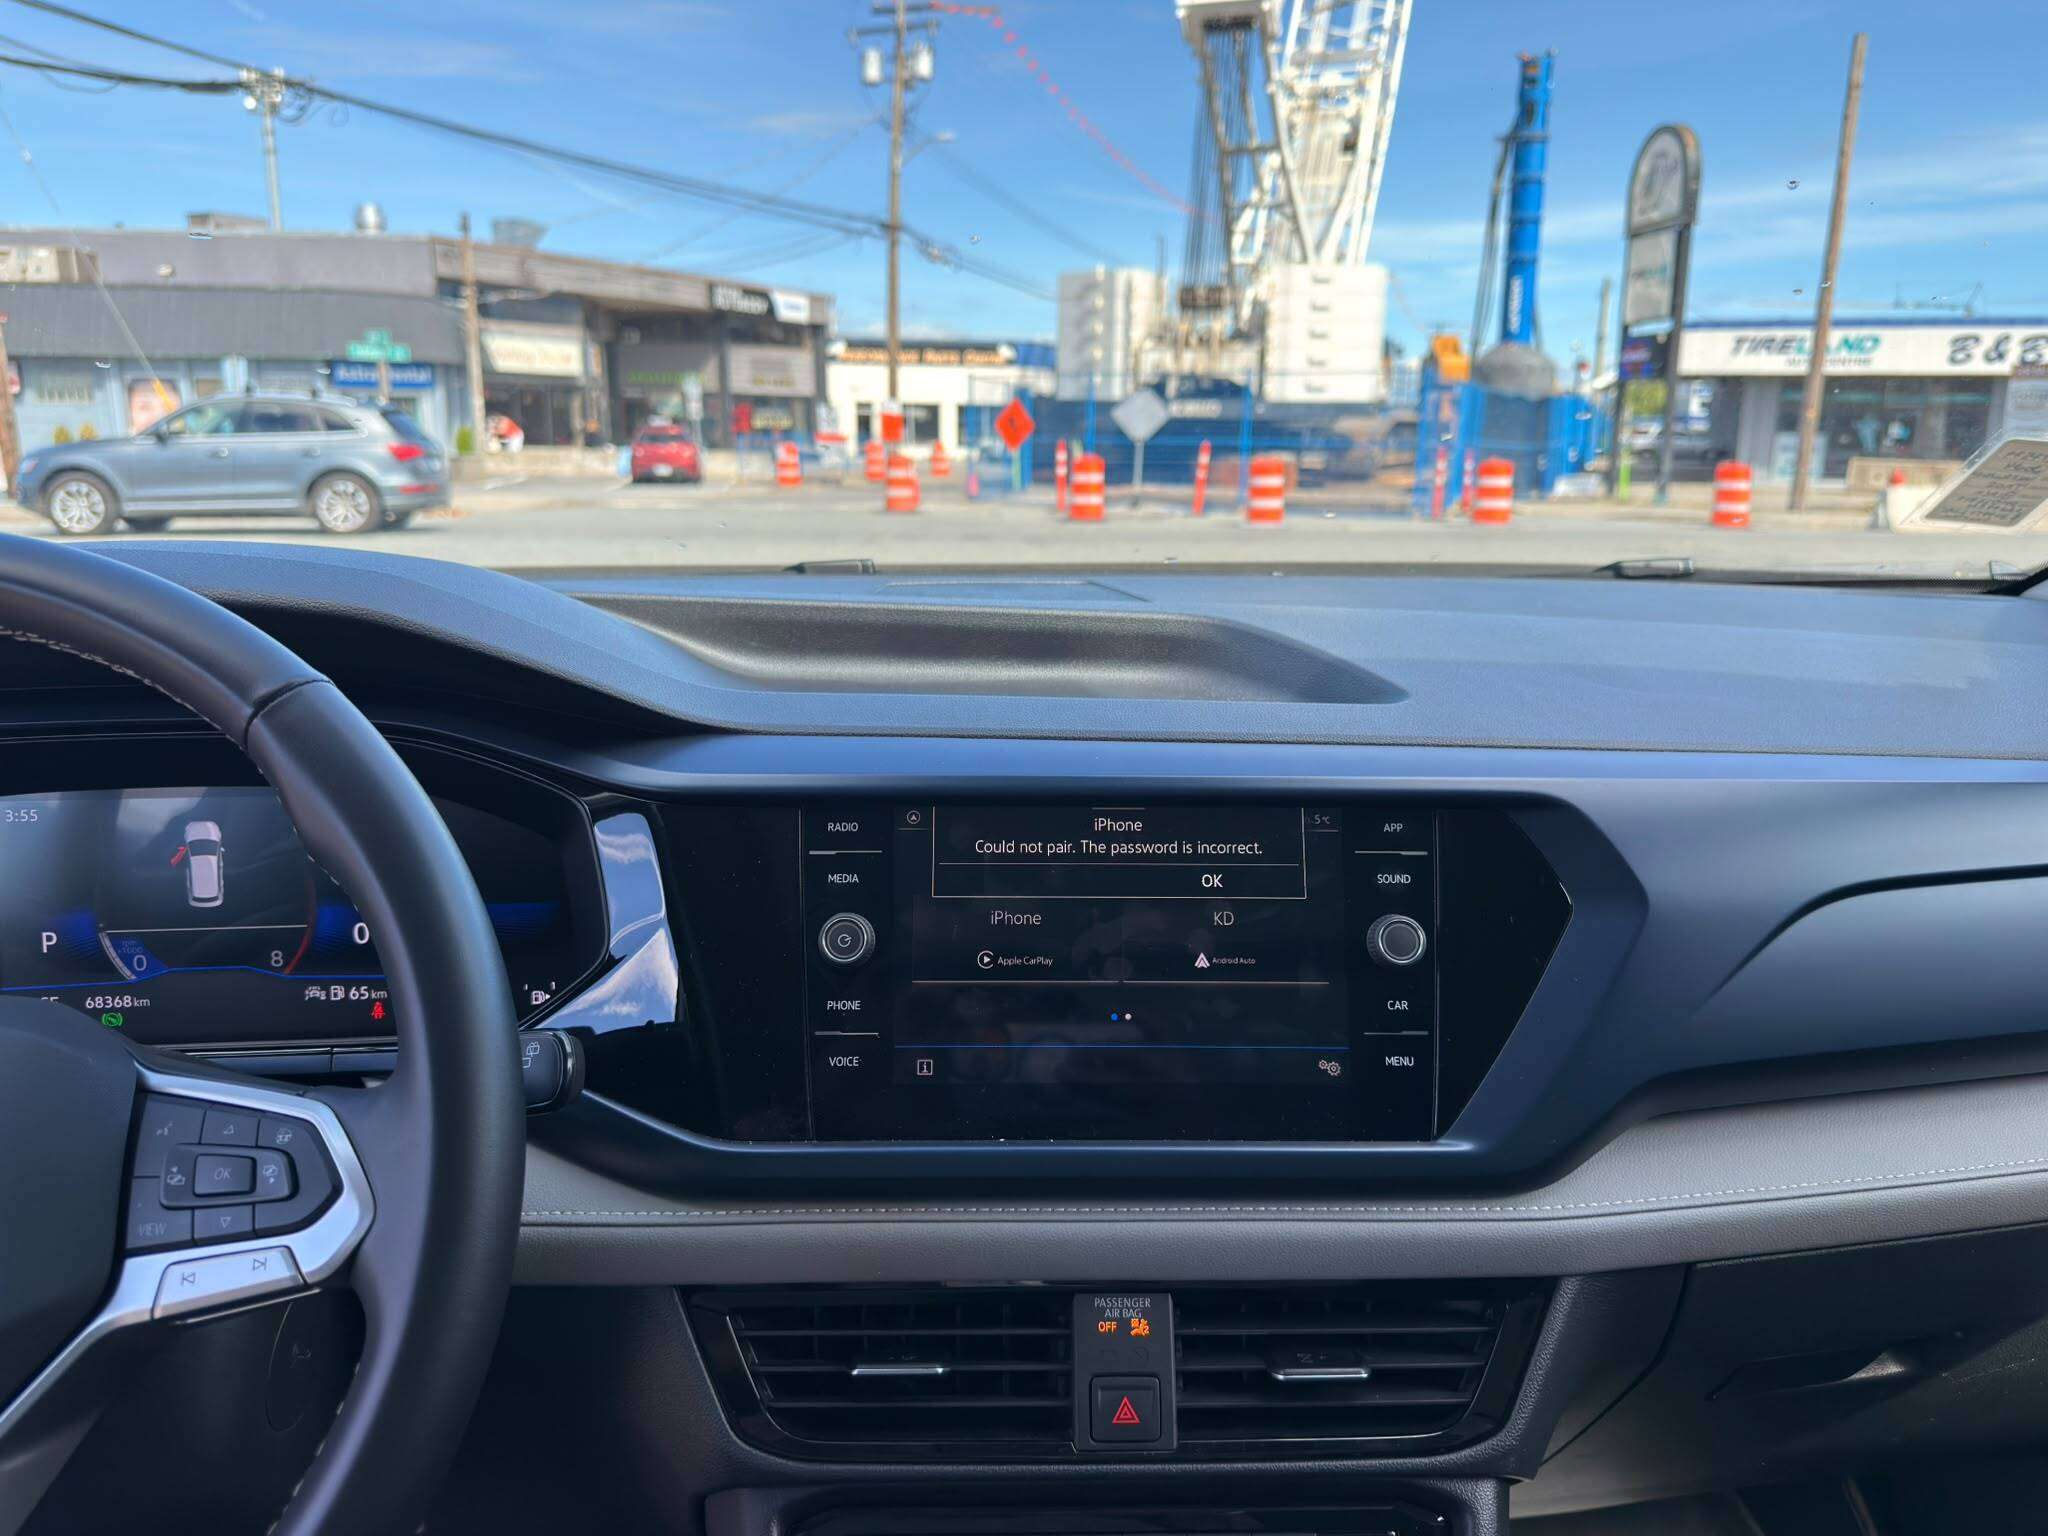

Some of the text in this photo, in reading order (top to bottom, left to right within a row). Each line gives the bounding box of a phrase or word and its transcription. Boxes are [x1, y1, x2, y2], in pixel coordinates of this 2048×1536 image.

[1730, 334, 1882, 356] TIRELND
[5, 809, 38, 822] 3:55
[827, 822, 859, 832] RADIO
[1094, 818, 1143, 832] iPhone
[1383, 823, 1403, 833] APP
[975, 840, 1263, 857] Could not pair. The password is incorrect.
[828, 873, 860, 884] MEDIA
[1201, 874, 1223, 888] OK
[1377, 874, 1411, 884] SOUND
[990, 910, 1042, 925] iPhone
[1213, 912, 1235, 926] KD
[353, 921, 370, 944] 0
[41, 931, 58, 953] P
[133, 955, 147, 971] 0
[271, 950, 283, 967] 8
[997, 956, 1053, 966] Apple CarPlay
[1212, 957, 1256, 965] Android Auto
[349, 986, 388, 1000] 65 km
[85, 996, 151, 1009] 68368 km
[827, 1000, 861, 1011] PHONE
[1387, 1000, 1409, 1011] CAR
[829, 1057, 860, 1067] VOICE
[1385, 1056, 1414, 1067] MENU
[214, 1168, 232, 1180] OK
[139, 1222, 167, 1236] VIEW
[1094, 1297, 1152, 1308] PASSENGER
[1104, 1308, 1142, 1318] AIR BAG
[1098, 1321, 1117, 1333] OFF
